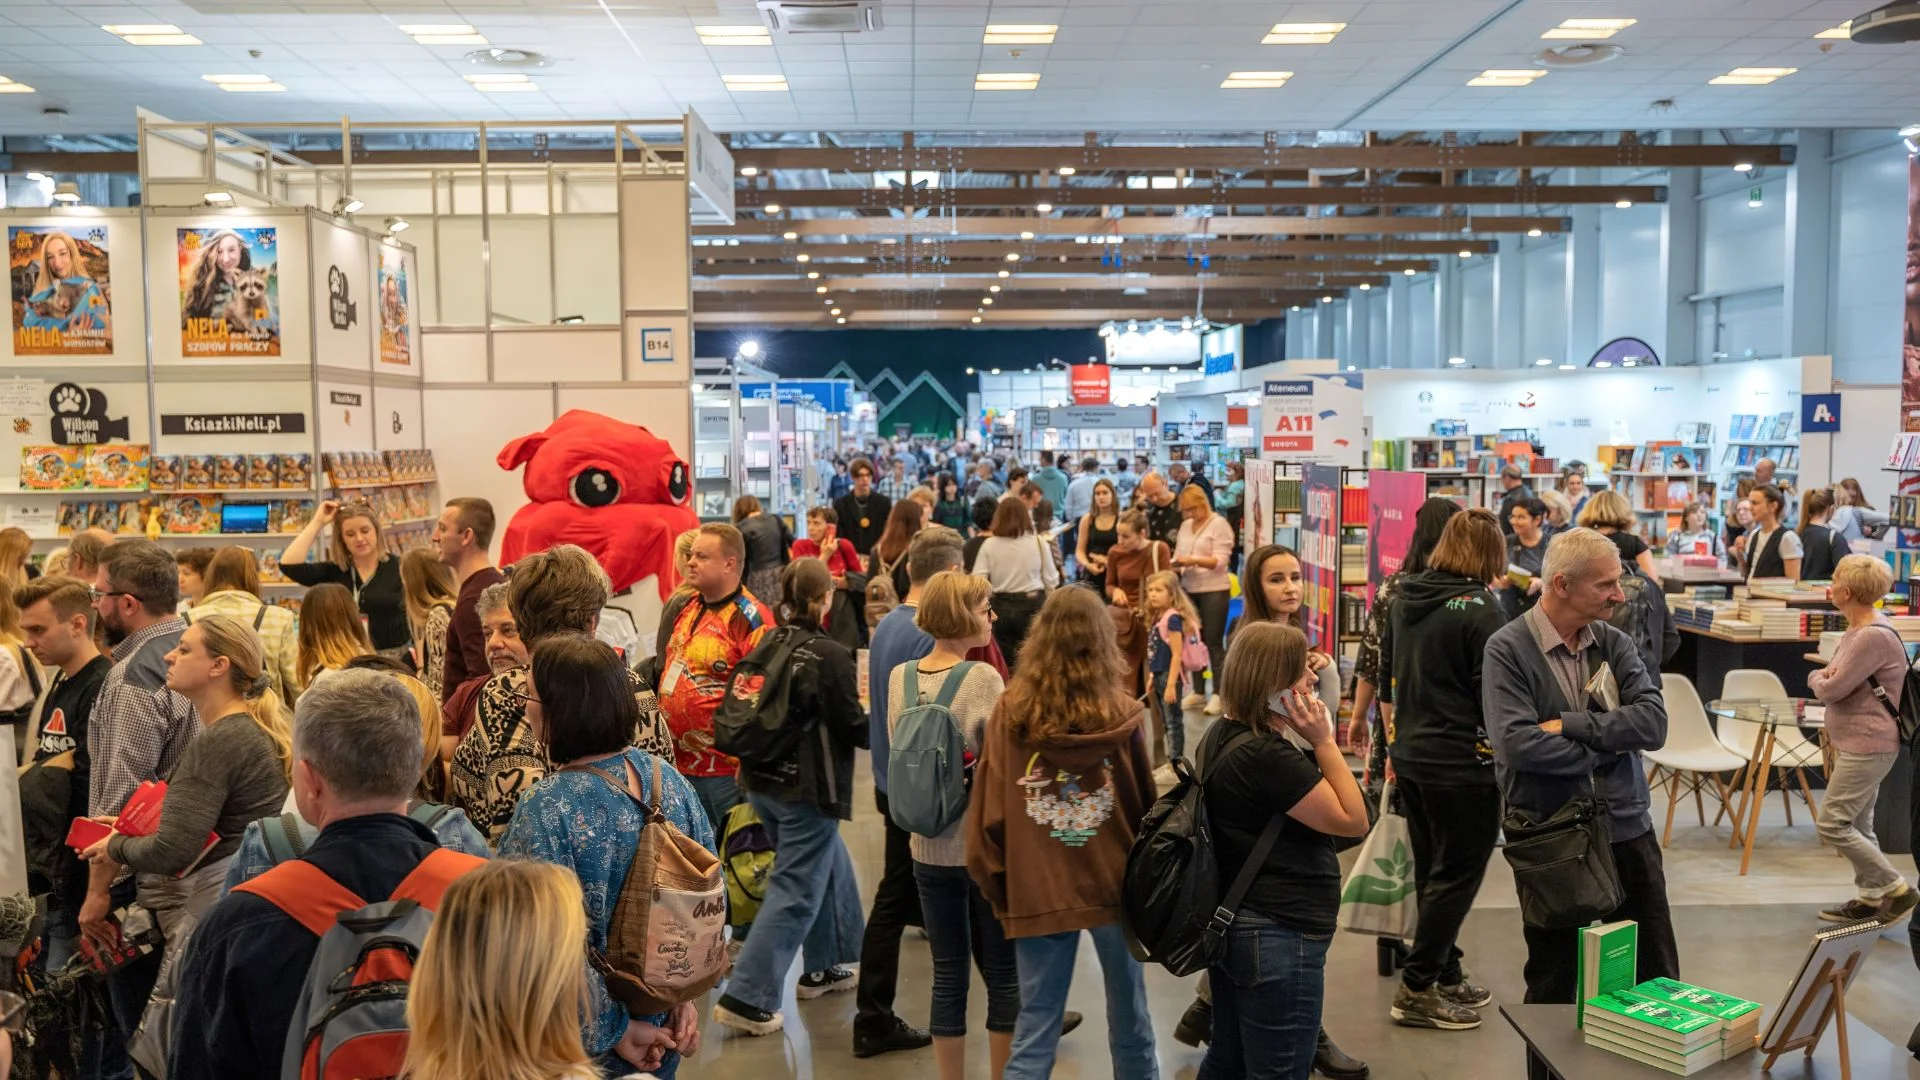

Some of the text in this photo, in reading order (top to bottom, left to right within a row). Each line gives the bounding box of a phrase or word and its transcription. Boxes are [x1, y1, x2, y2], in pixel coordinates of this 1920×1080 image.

[187, 317, 229, 339] NELA
[19, 326, 61, 348] NELA
[646, 340, 669, 351] B14
[1267, 383, 1309, 394] Ateneum
[61, 416, 99, 432] Willson
[184, 415, 282, 433] KsiazkiNeli.pl
[1276, 415, 1313, 432] A11
[66, 430, 97, 444] Media
[1382, 507, 1403, 521] MARIA
